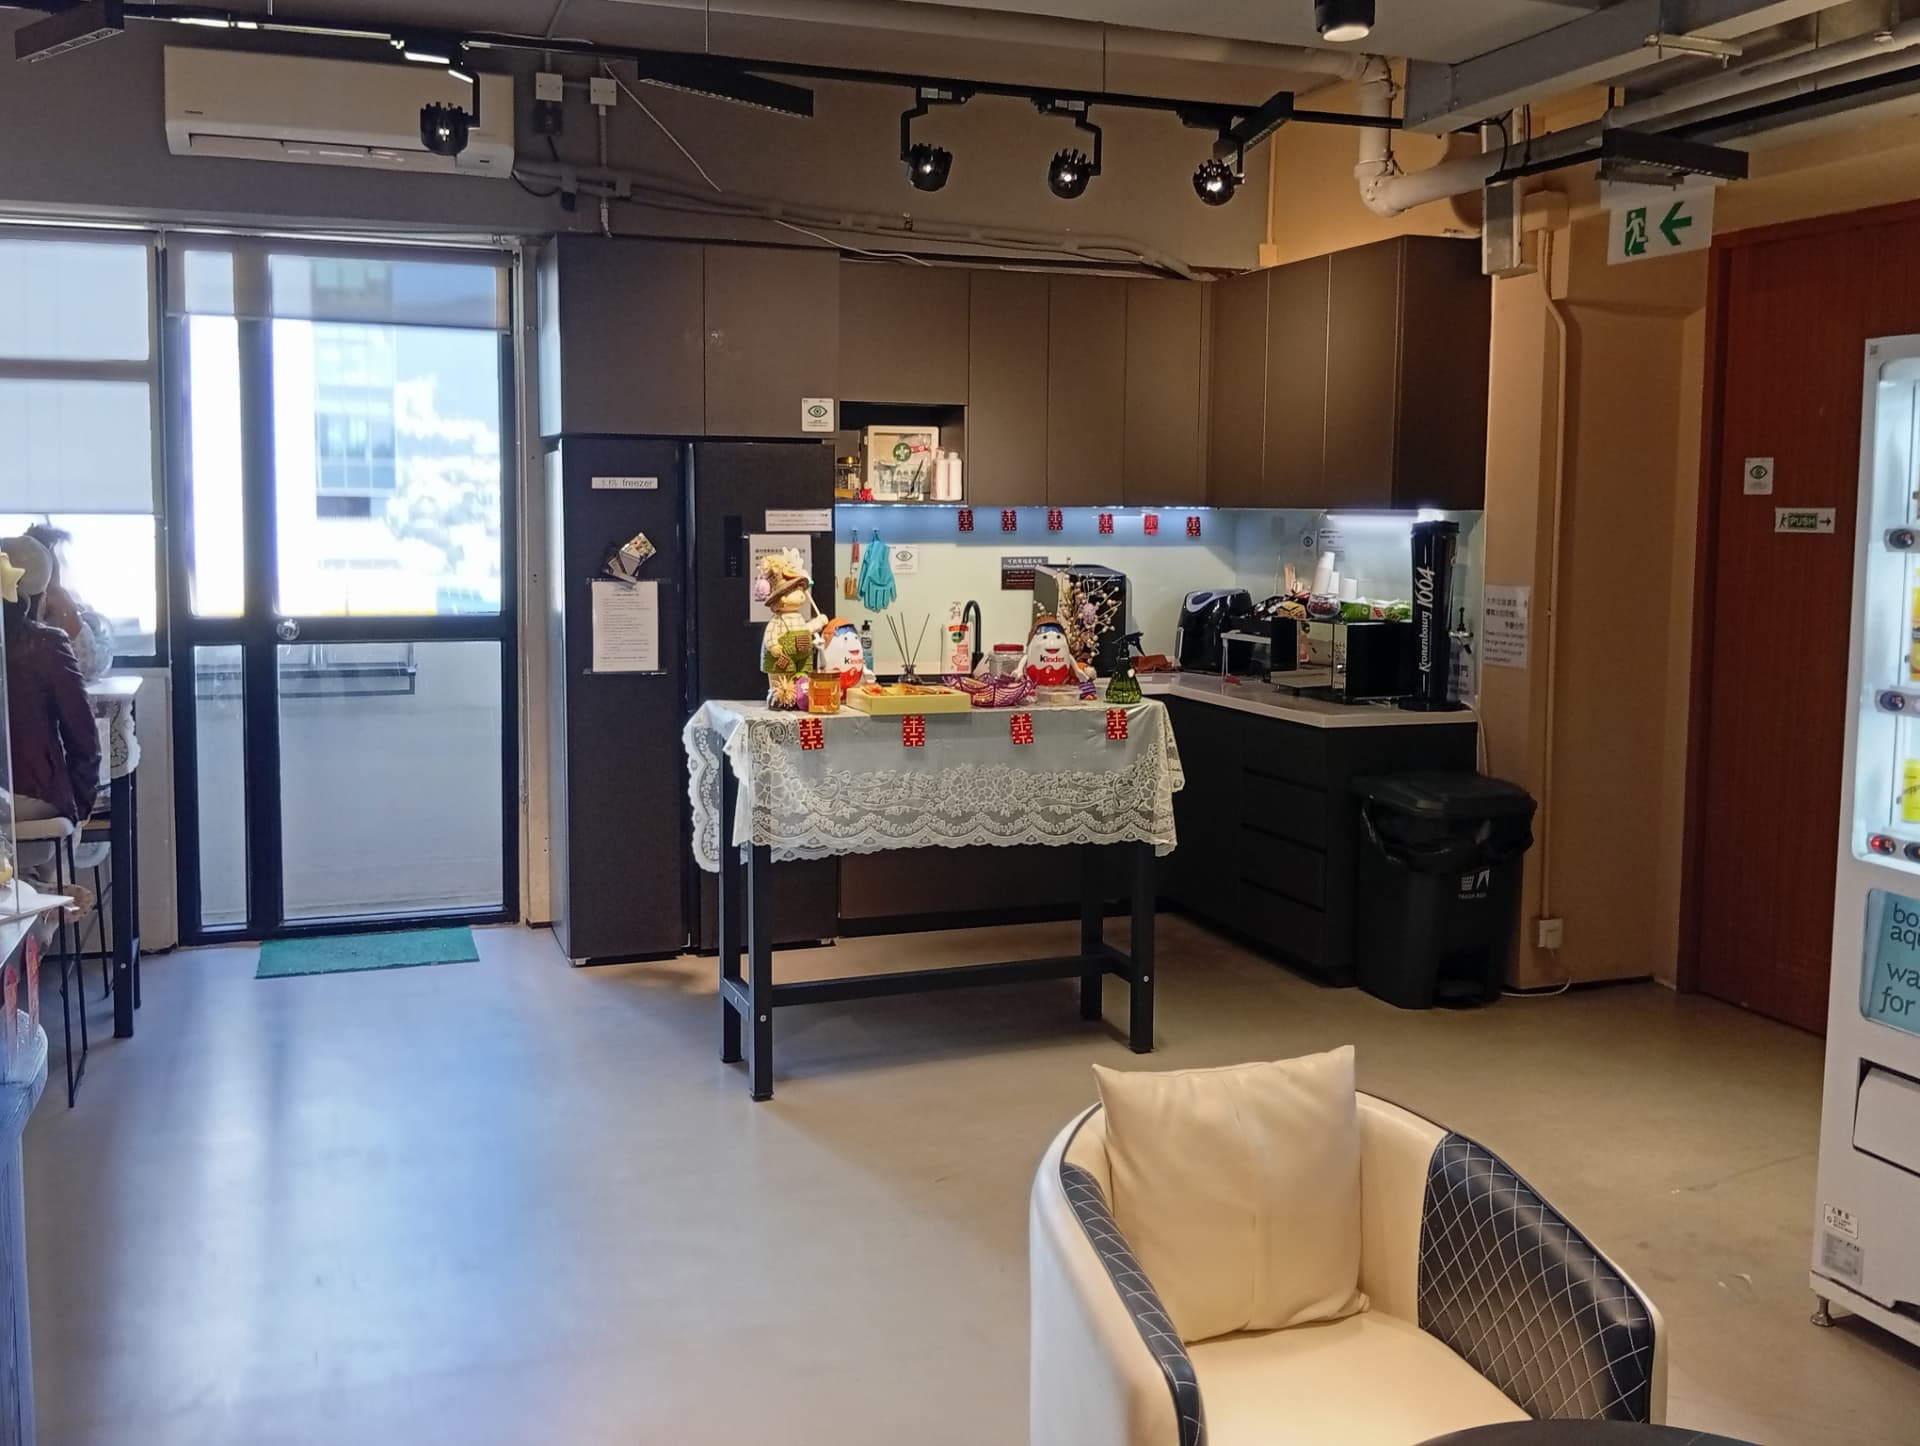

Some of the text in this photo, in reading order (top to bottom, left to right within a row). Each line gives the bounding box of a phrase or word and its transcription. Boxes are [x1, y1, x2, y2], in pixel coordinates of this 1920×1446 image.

[622, 478, 655, 488] freezer
[1790, 516, 1816, 527] PUSH
[1415, 566, 1435, 672] Kronenbourg 1664
[1893, 902, 1920, 928] bo
[1890, 925, 1920, 951] aq
[1878, 986, 1916, 1016] for
